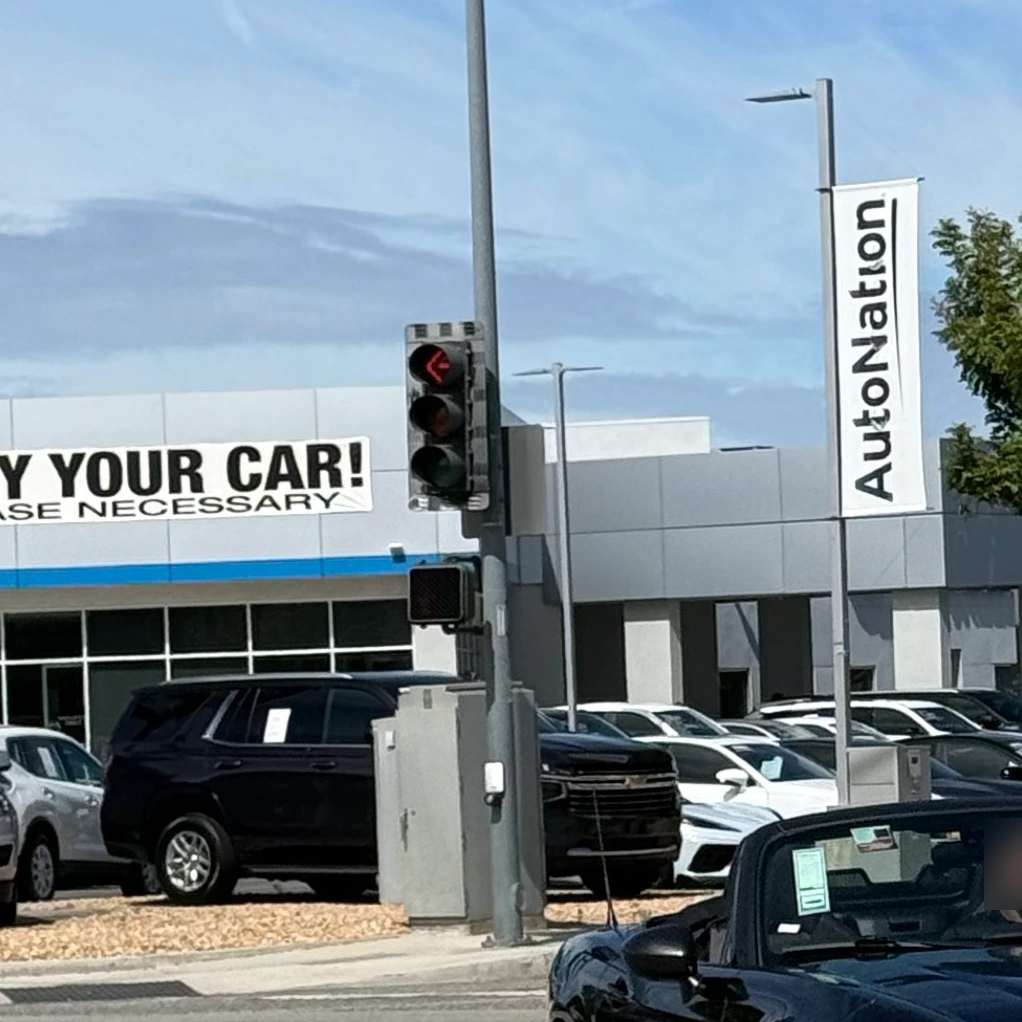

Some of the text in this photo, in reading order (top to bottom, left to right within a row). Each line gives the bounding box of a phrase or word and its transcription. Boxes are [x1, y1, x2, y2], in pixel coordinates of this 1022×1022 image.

[849, 199, 893, 502] AutoNation
[48, 449, 204, 498] YOUR
[227, 442, 363, 492] CAR!
[0, 492, 340, 521] SE NECESSARY
